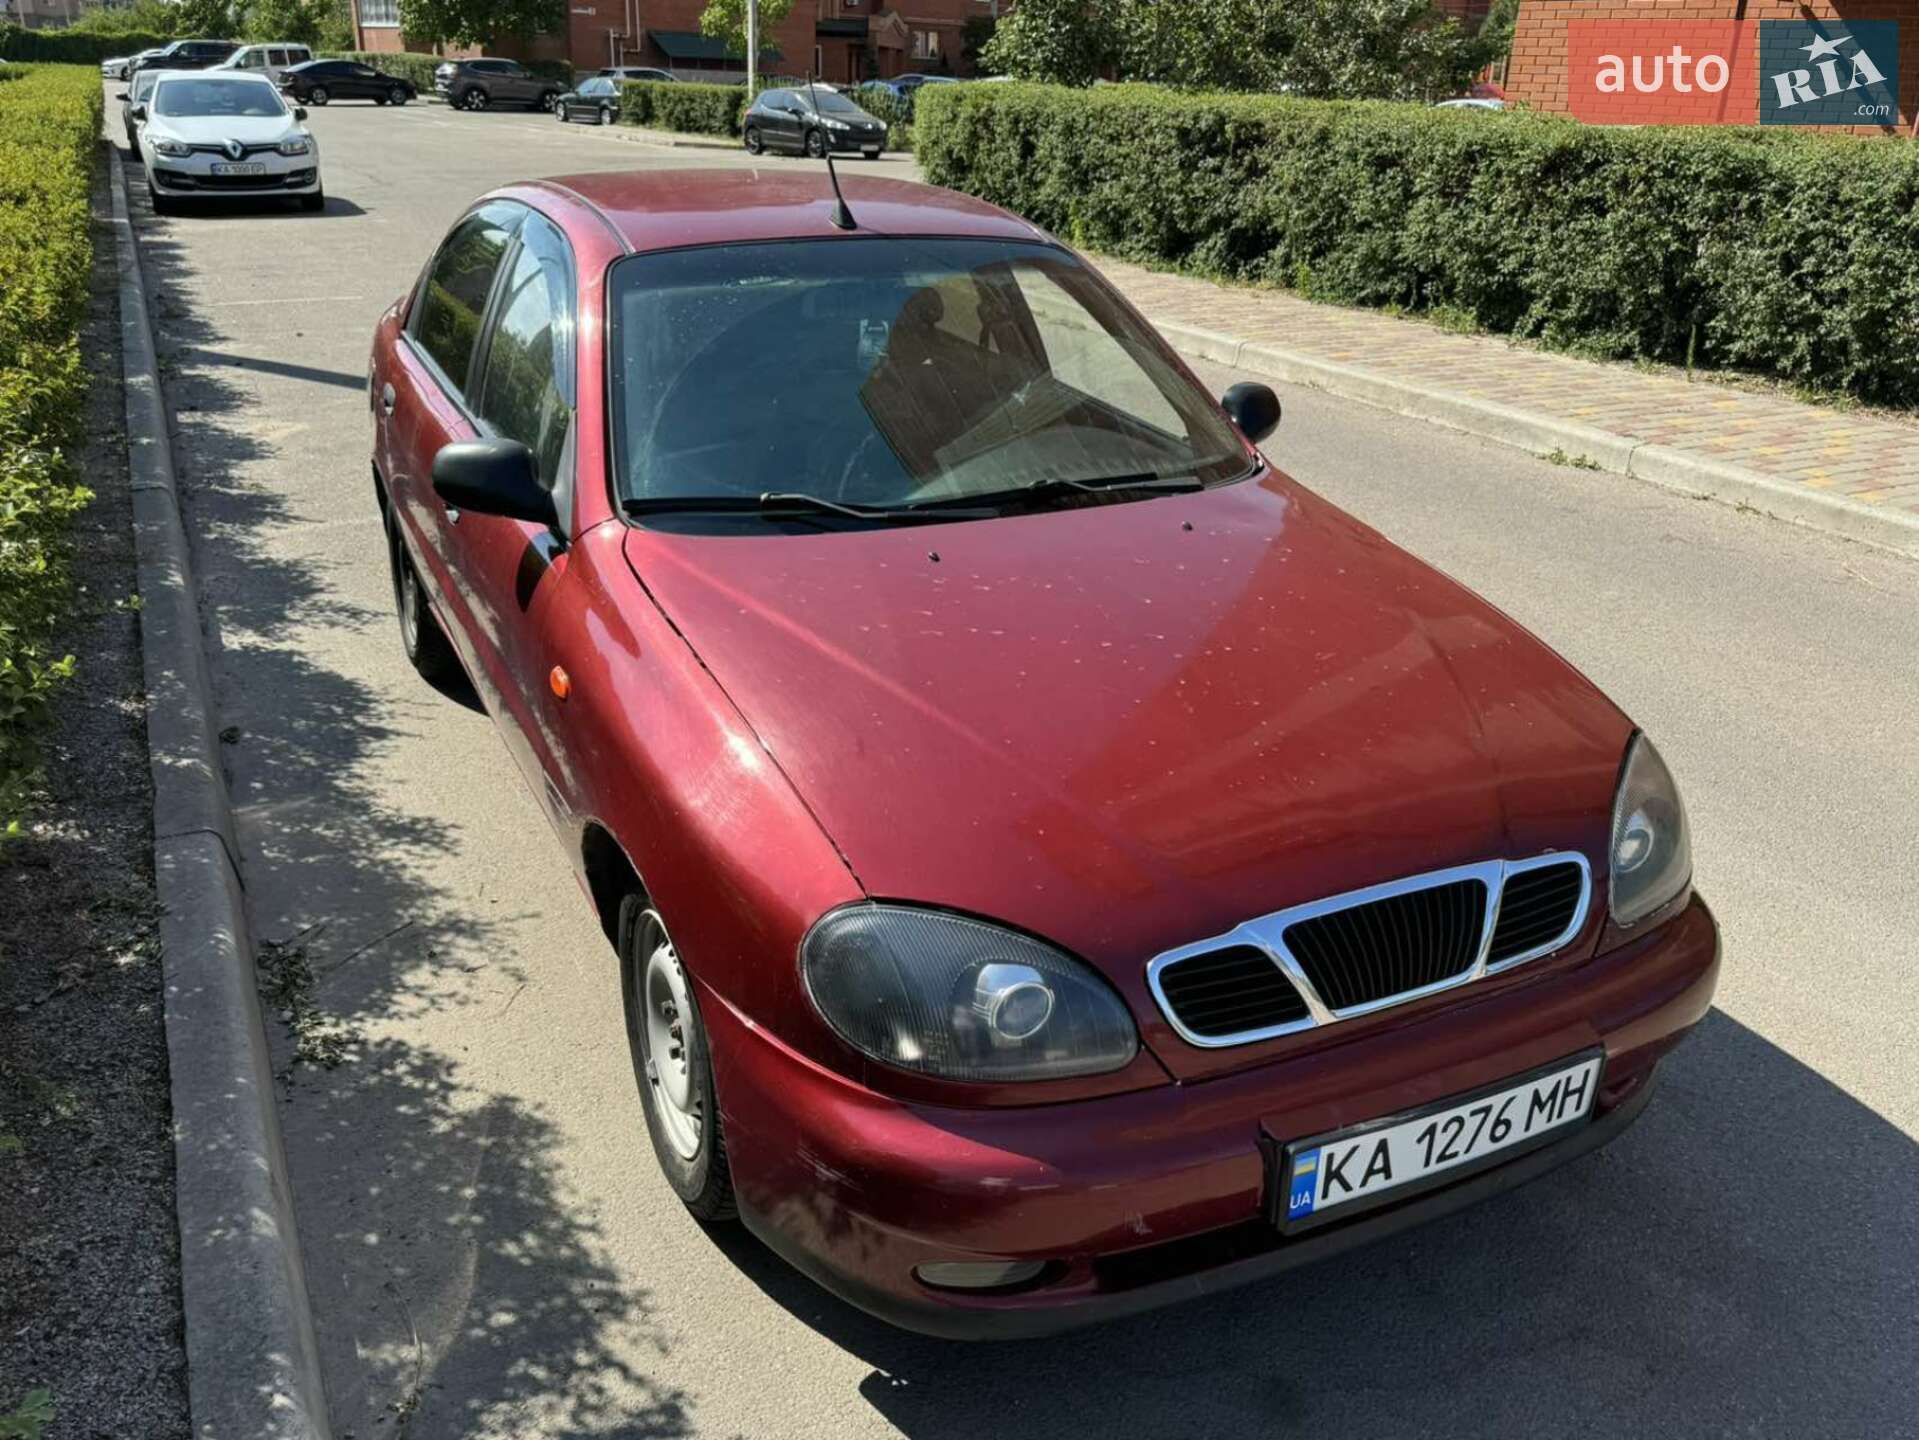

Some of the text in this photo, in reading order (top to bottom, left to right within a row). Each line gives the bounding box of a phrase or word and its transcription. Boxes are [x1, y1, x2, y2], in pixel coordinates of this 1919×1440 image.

[1322, 1069, 1590, 1199] KA 1276 MH
[1289, 1191, 1311, 1209] UA
